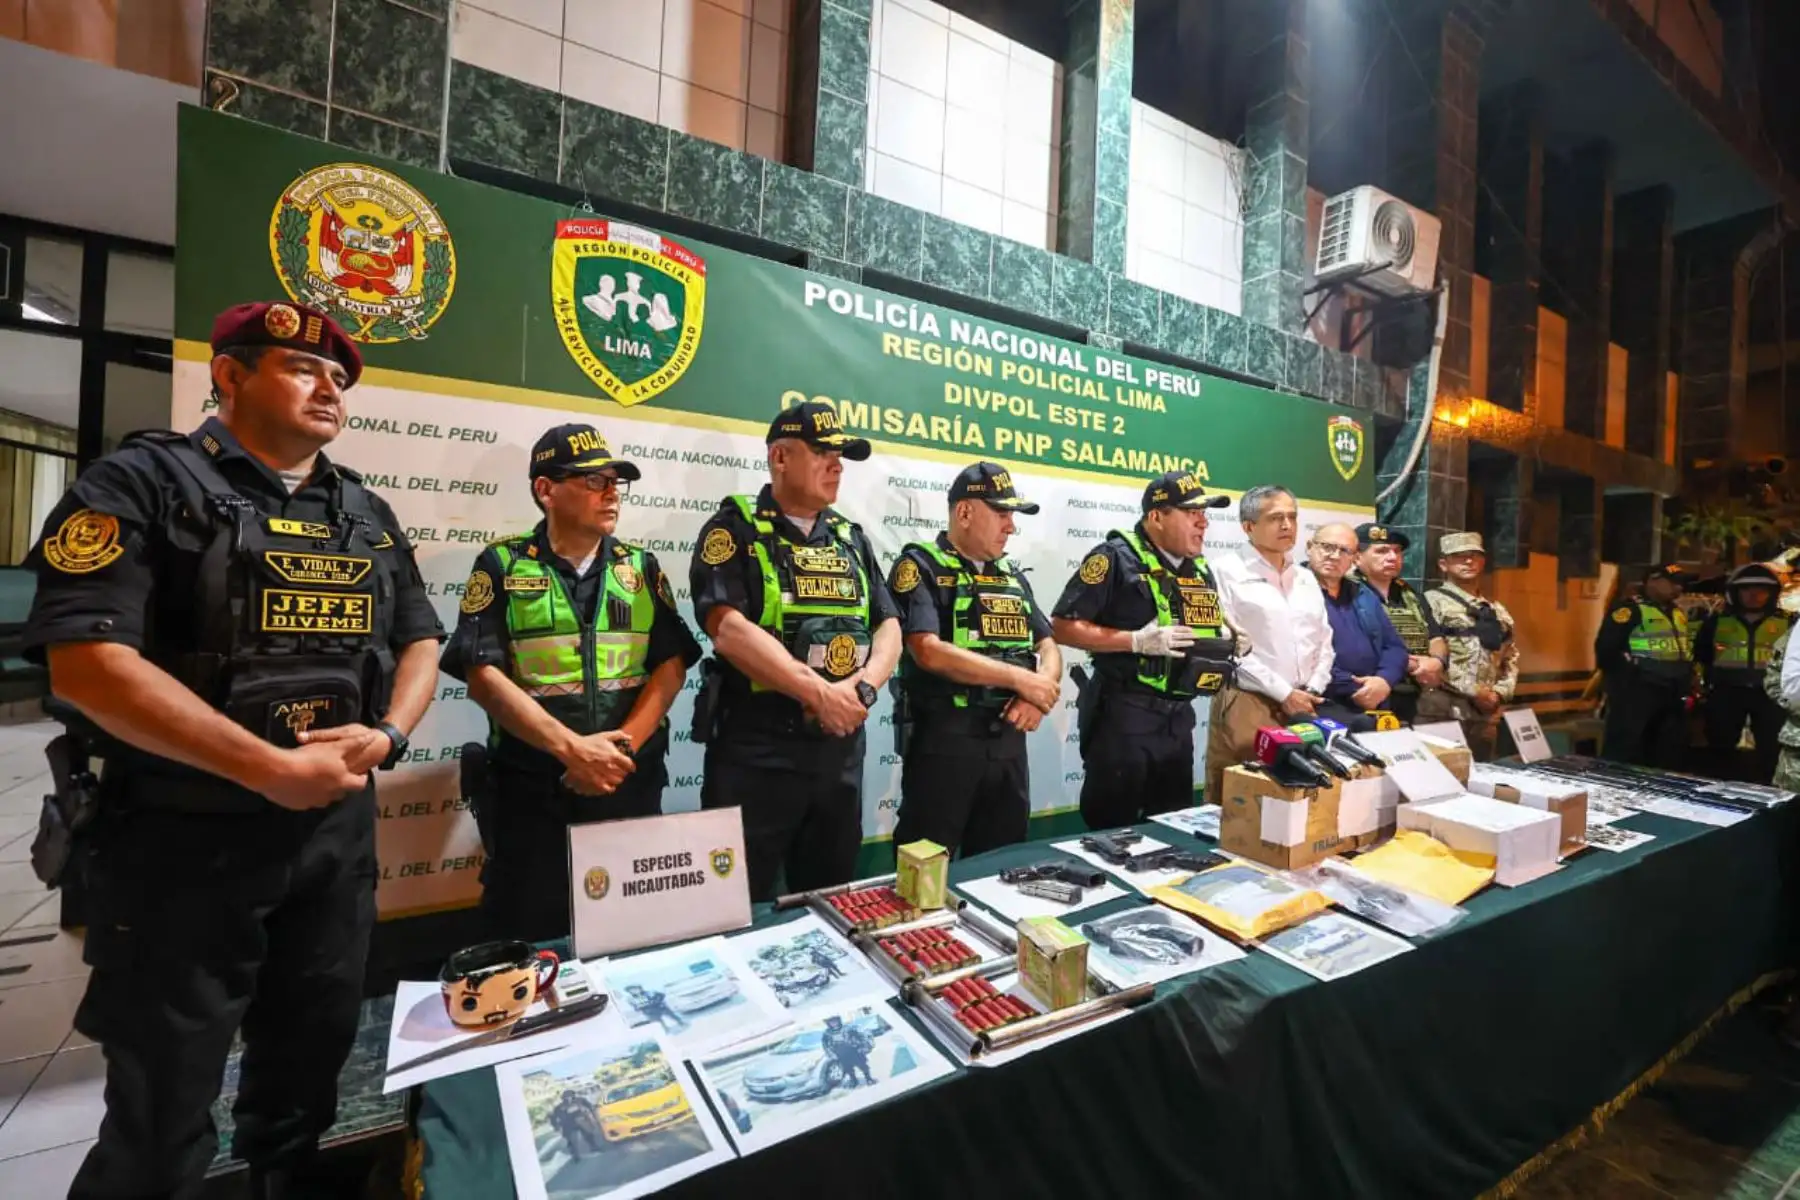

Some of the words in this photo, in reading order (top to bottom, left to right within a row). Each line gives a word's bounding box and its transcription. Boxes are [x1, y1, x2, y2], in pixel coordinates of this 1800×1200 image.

[573, 241, 628, 254] REGIÓN
[632, 248, 692, 285] POLICIAL
[343, 298, 389, 317] PATRIA
[603, 334, 653, 360] LIMA
[803, 279, 941, 340] POLICÍA
[950, 316, 1089, 374] NACIONAL
[1095, 354, 1140, 385] DEL
[1144, 366, 1202, 399] PERÚ
[561, 317, 603, 379] SERVICIO
[604, 376, 621, 395] DE
[631, 385, 650, 399] LA
[649, 325, 697, 390] COMUNIDAD
[882, 331, 994, 378] REGIÓN
[1001, 359, 1111, 403] POLICIAL
[1116, 387, 1168, 414] LIMA
[944, 381, 1042, 422] DIVPOL
[1048, 402, 1107, 433] ESTE
[1111, 415, 1126, 436] 2
[343, 415, 403, 435] IONAL
[407, 422, 444, 439] DEL
[447, 427, 499, 445] PERU
[620, 443, 679, 461] POLICIA
[681, 451, 750, 471] NACIONAL
[994, 427, 1053, 461] PNP
[1061, 437, 1211, 482] SALAMANCA
[407, 475, 444, 493] DEL
[447, 480, 499, 497] PERU
[888, 475, 928, 490] POLICIA
[618, 492, 677, 510] POLICIA
[405, 526, 442, 542] DEL
[446, 528, 497, 544] PERU
[301, 558, 341, 573] VIDAL
[799, 578, 840, 598] POLICIA
[272, 595, 364, 616] JEFE
[271, 615, 364, 629] DIVEME
[399, 747, 435, 764] DEL
[399, 801, 436, 819] DEL
[399, 861, 436, 879] DEL
[633, 851, 693, 874] ESPECIES
[622, 870, 706, 898] INCAUTADAS
